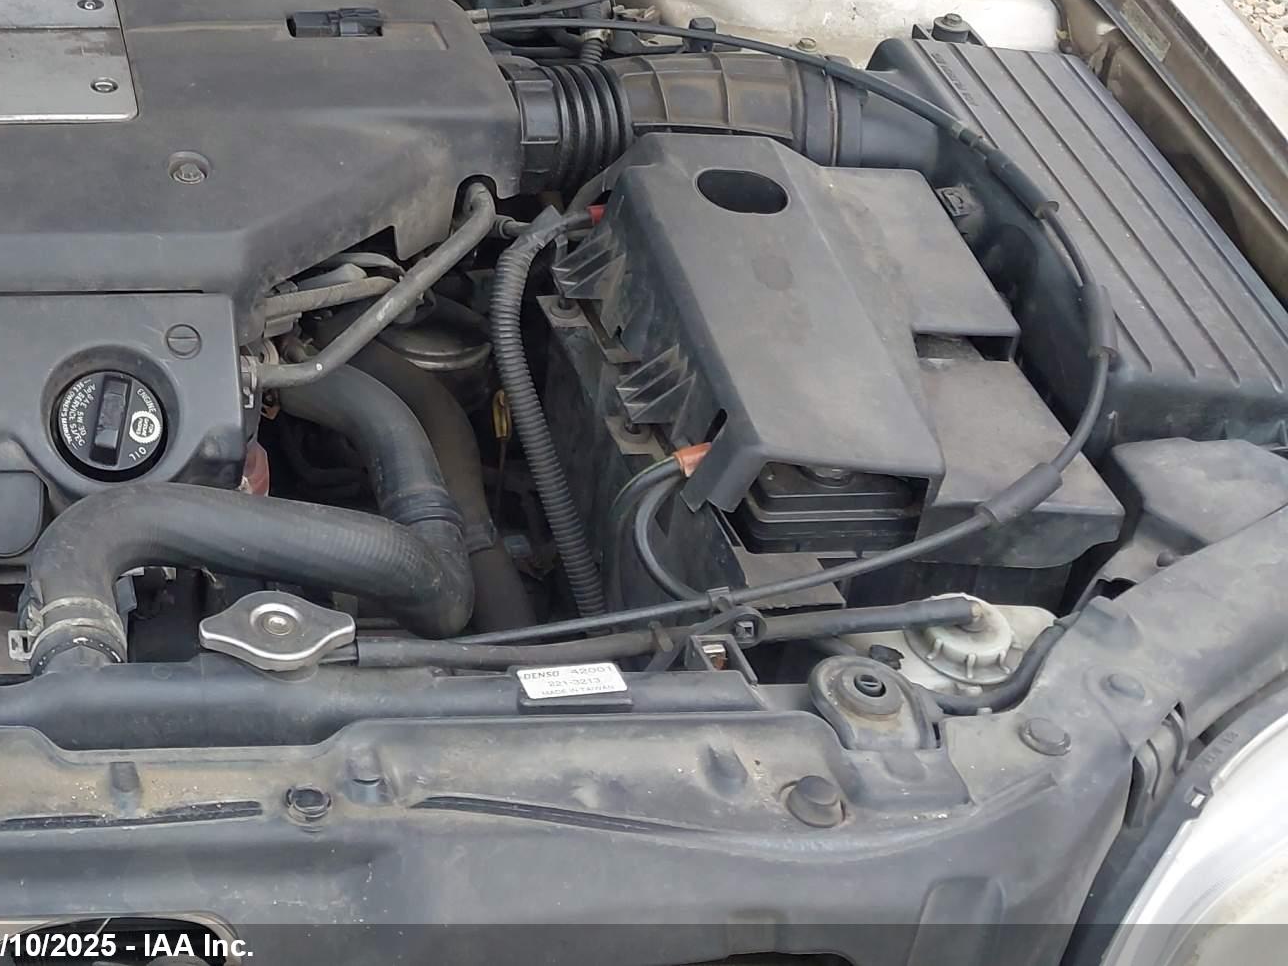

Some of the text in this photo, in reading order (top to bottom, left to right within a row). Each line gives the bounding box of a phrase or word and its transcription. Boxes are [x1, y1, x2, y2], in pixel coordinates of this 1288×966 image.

[68, 392, 85, 421] SERVICE
[80, 393, 95, 409] SAE
[128, 388, 157, 461] ENGINE OIL
[524, 670, 560, 680] DENSO
